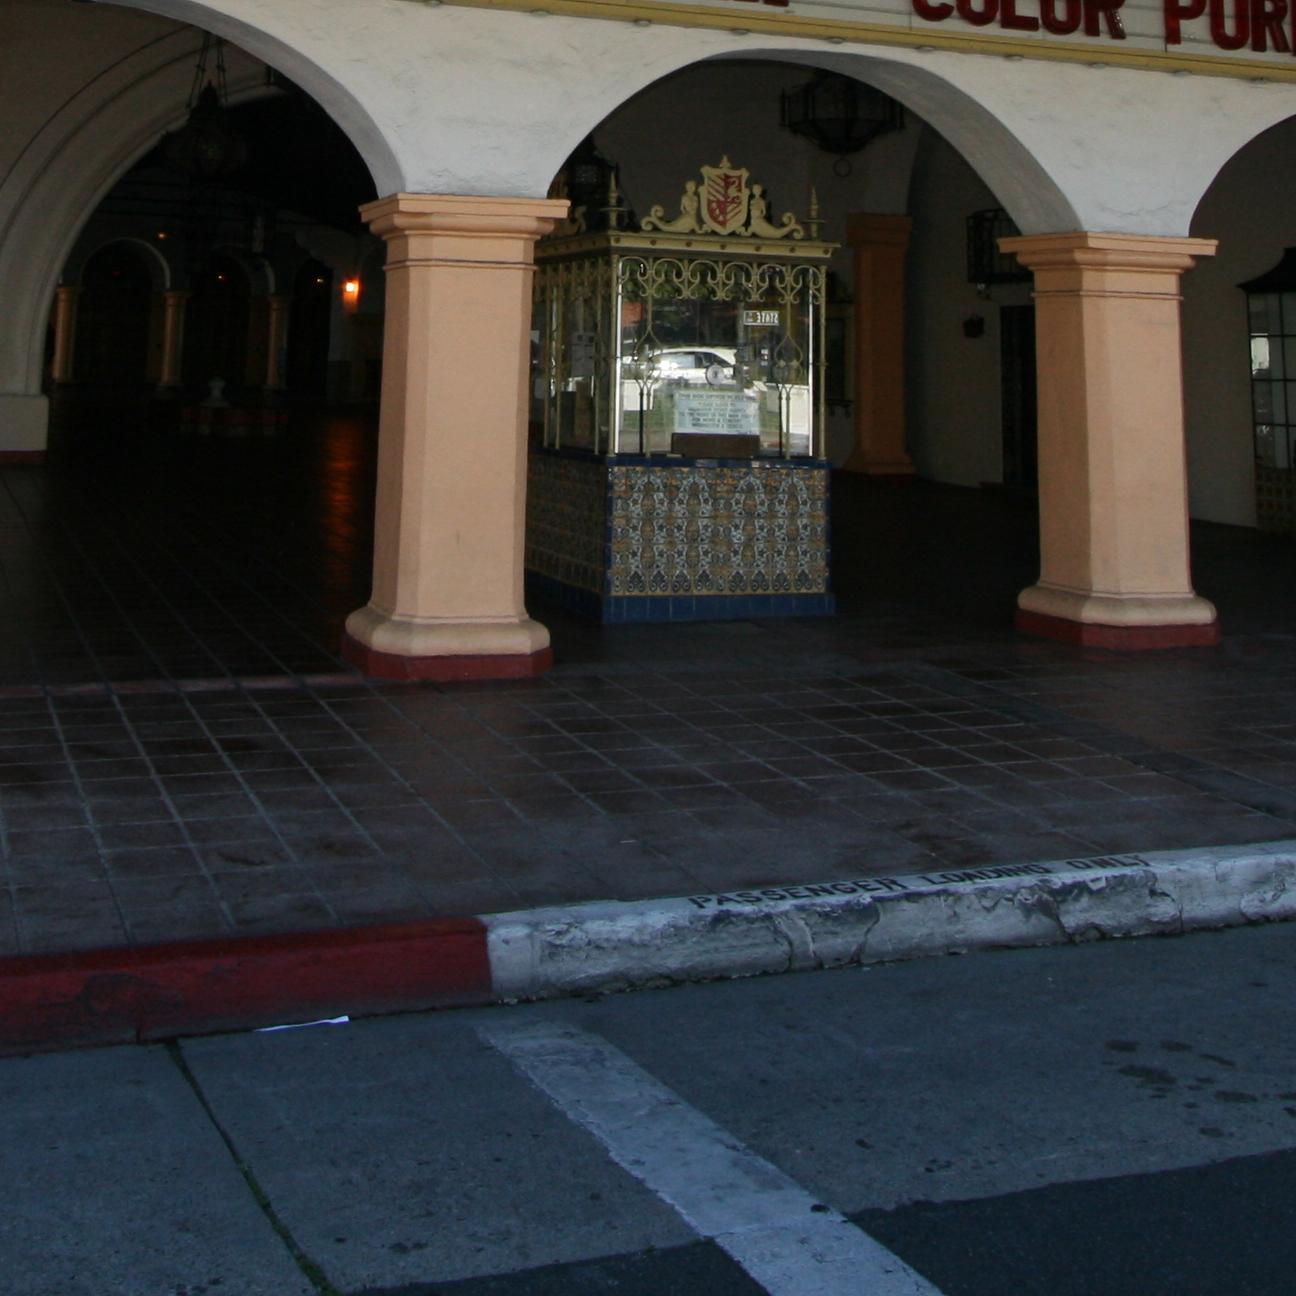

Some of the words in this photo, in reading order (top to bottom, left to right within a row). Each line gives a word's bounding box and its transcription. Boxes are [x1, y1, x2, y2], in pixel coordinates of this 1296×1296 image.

[688, 876, 907, 909] PASSENGER
[918, 862, 1053, 885] LOADING
[1066, 853, 1151, 870] ONLY
